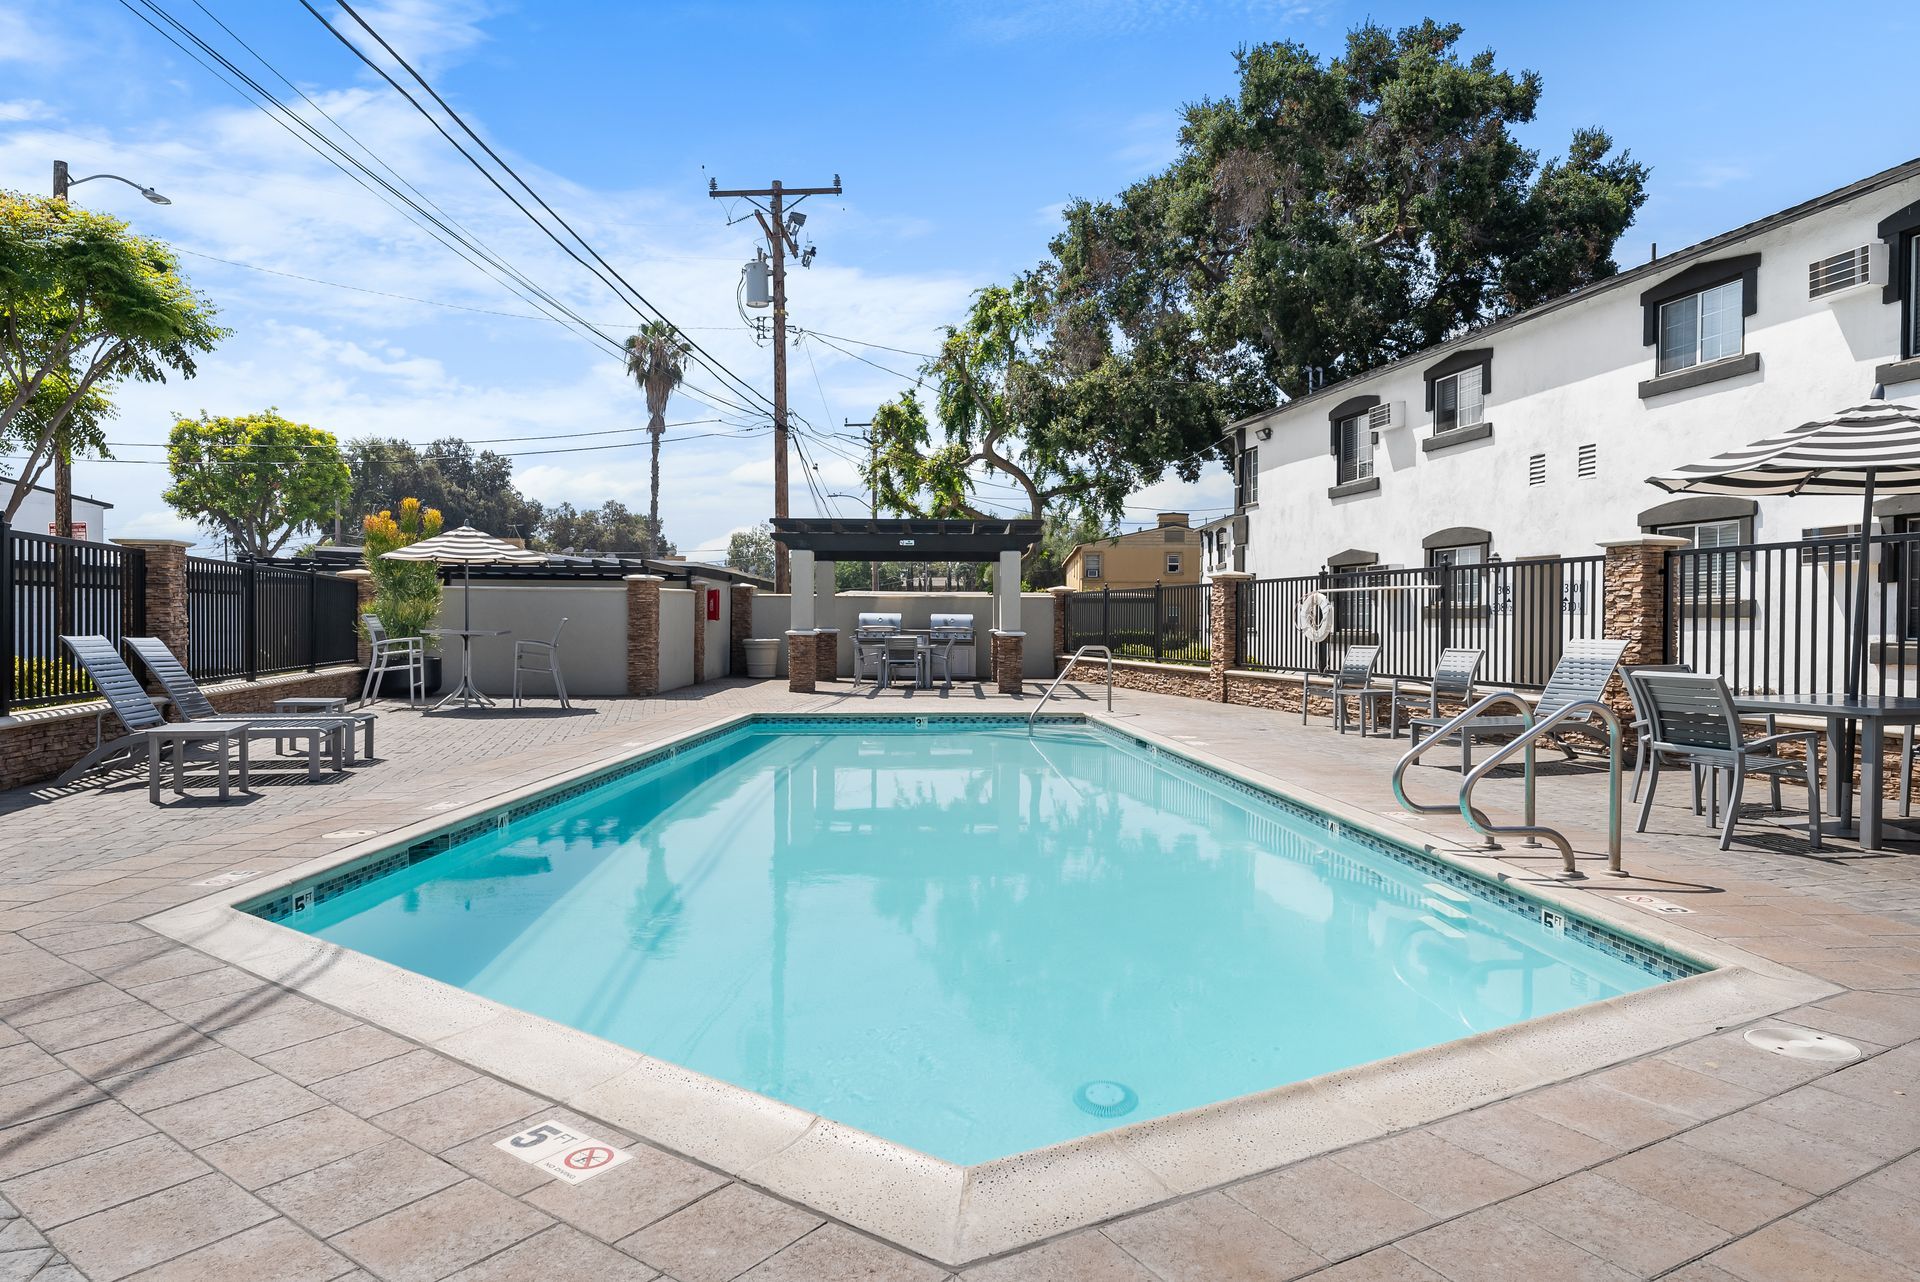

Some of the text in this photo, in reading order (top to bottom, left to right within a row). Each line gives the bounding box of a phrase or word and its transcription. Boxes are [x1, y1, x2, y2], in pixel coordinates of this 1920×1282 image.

[295, 892, 312, 912] 5 FT
[1544, 911, 1562, 928] 5 FT
[510, 1124, 578, 1148] 5 FT
[545, 1162, 576, 1181] NO DIVING
